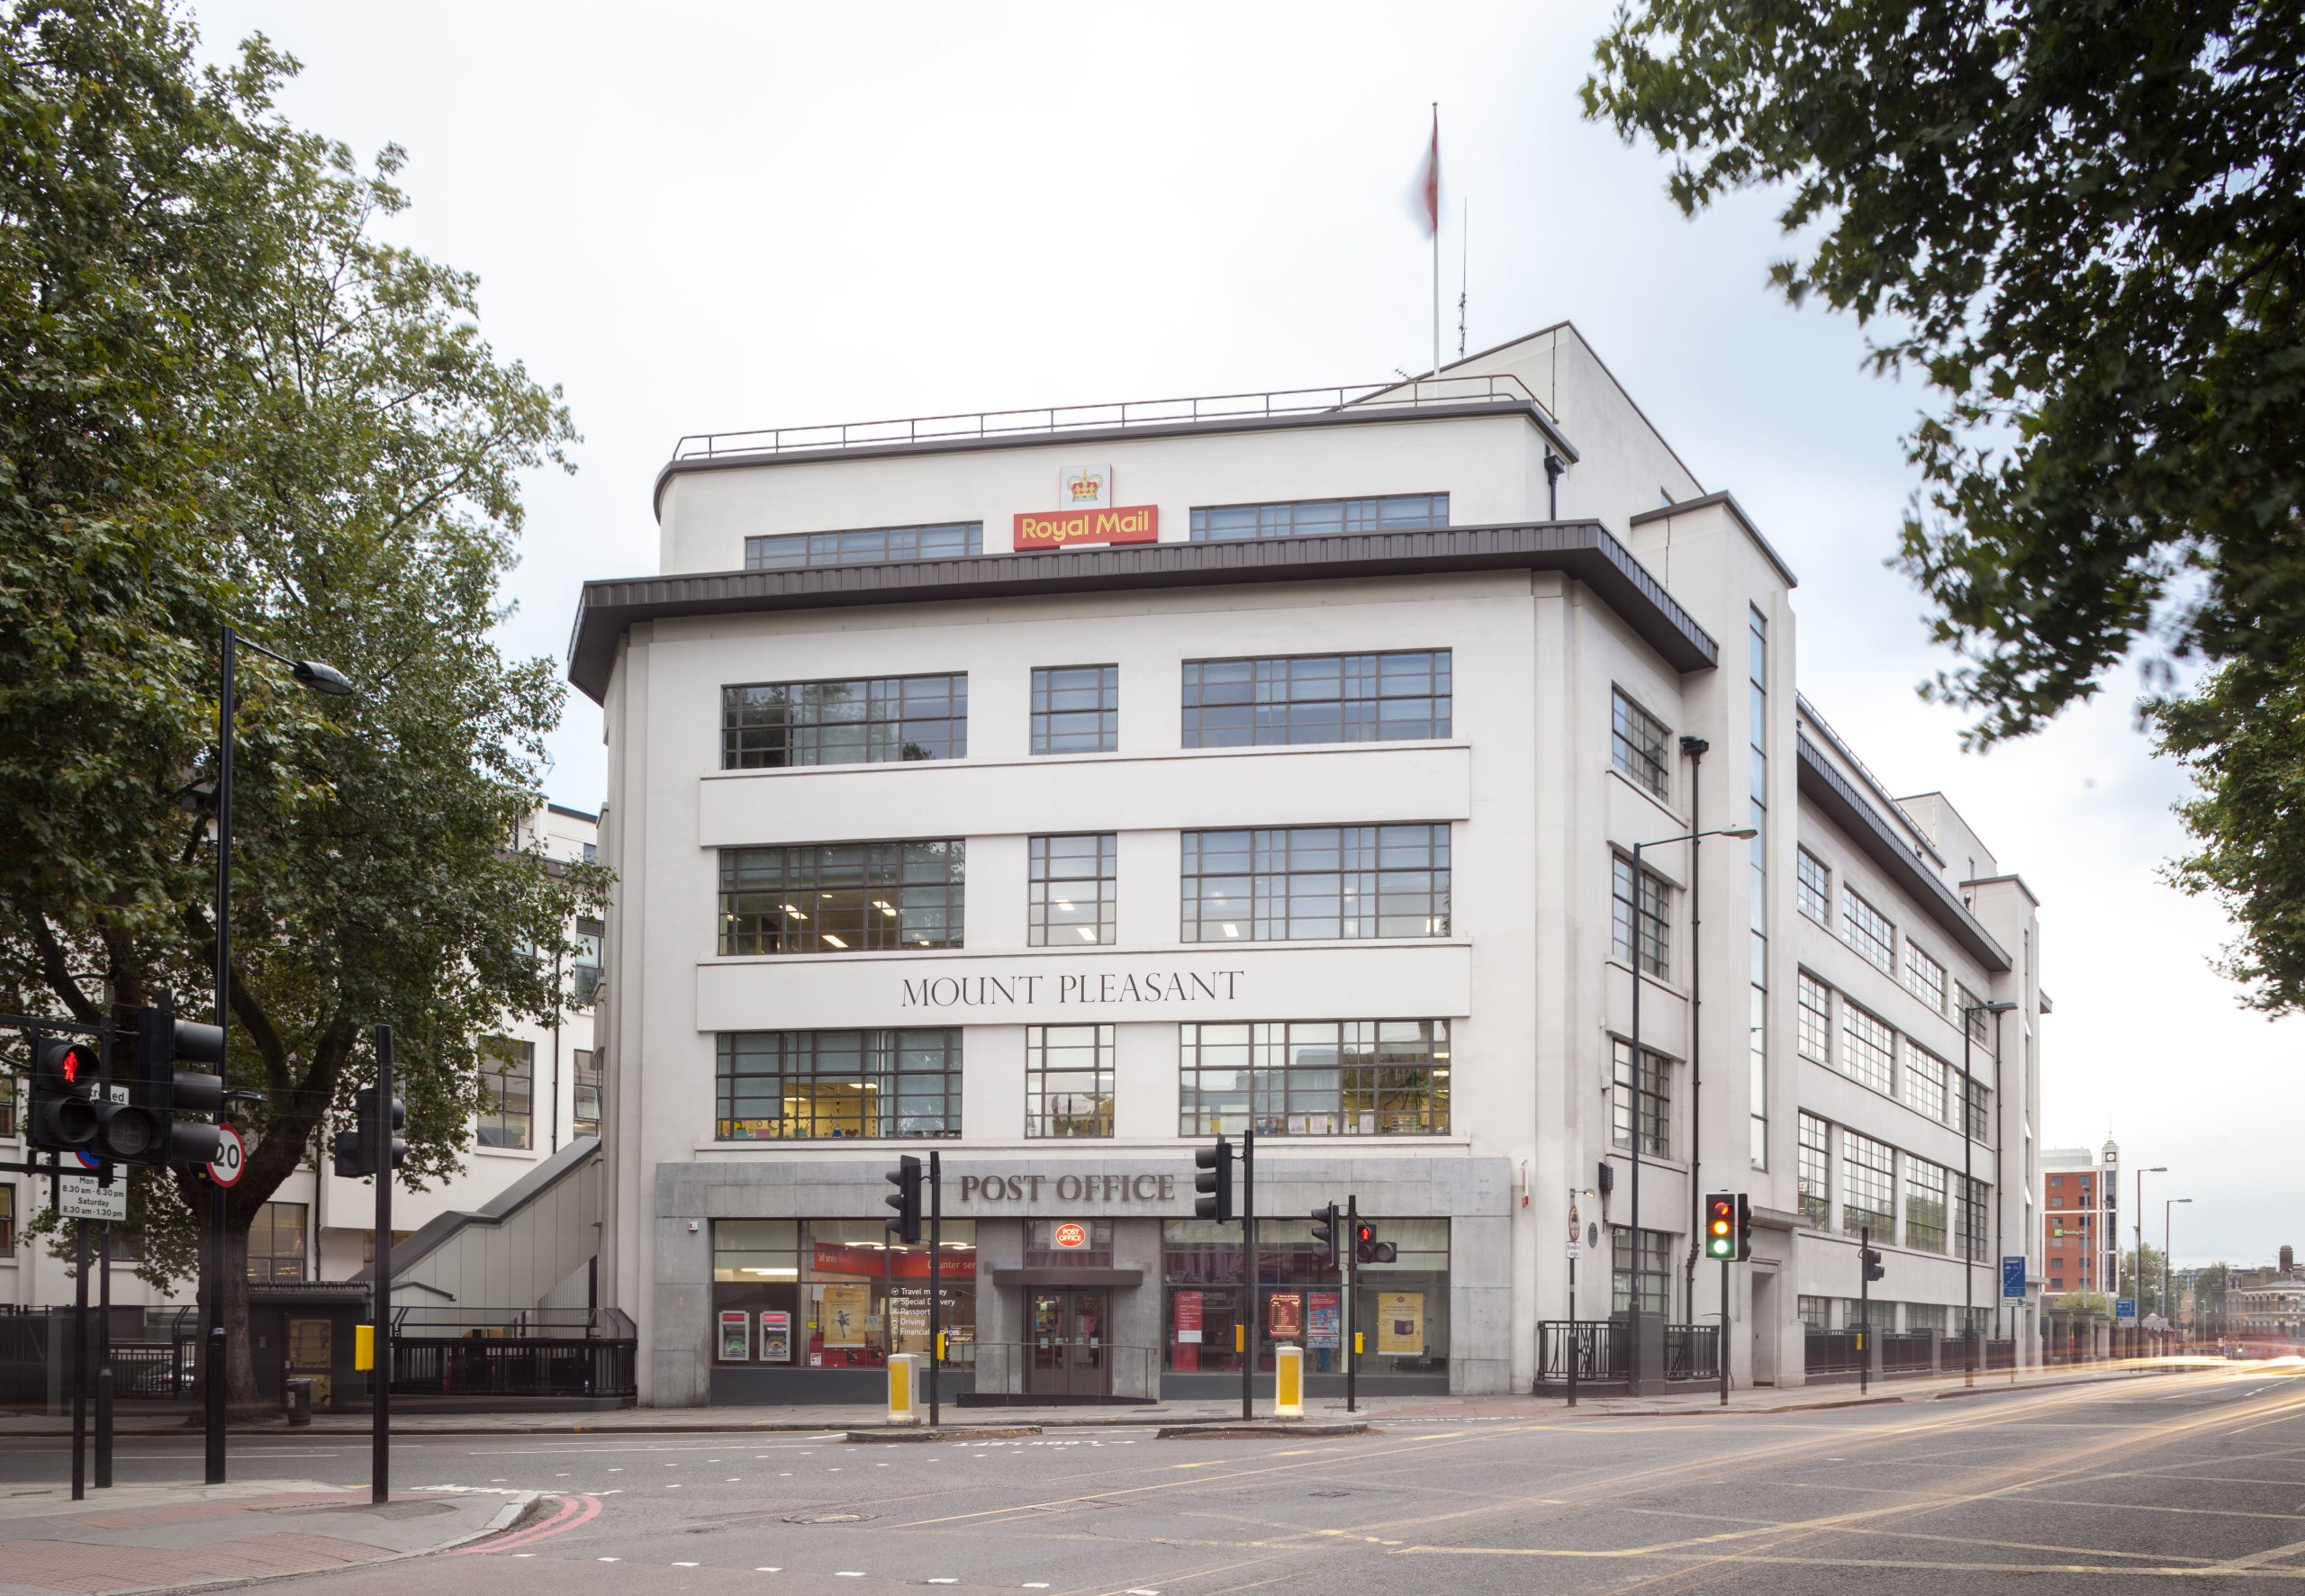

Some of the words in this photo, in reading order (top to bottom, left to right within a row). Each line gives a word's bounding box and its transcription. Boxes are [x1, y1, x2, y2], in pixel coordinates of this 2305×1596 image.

[1022, 514, 1089, 542] Royal
[1096, 510, 1149, 536] Mail
[901, 976, 1044, 1007] MOUNT
[1059, 970, 1244, 1004] PLEASANT
[214, 1141, 240, 1168] 20
[79, 1177, 95, 1186] Mon
[62, 1185, 80, 1194] 8.30
[81, 1187, 92, 1195] am
[96, 1187, 113, 1197] 6.30
[113, 1190, 124, 1198] pm
[960, 1175, 1045, 1202] POST
[1056, 1175, 1175, 1202] OFFICE
[77, 1197, 110, 1208] Saturday
[62, 1205, 80, 1214] 8.30
[96, 1208, 112, 1217] 1.30
[113, 1210, 123, 1218] pm
[900, 1287, 922, 1295] Travel
[923, 1288, 947, 1297] mey
[900, 1298, 926, 1307] Special
[927, 1298, 956, 1307] Dvery
[900, 1318, 926, 1327] Driving
[900, 1328, 930, 1336] Financial
